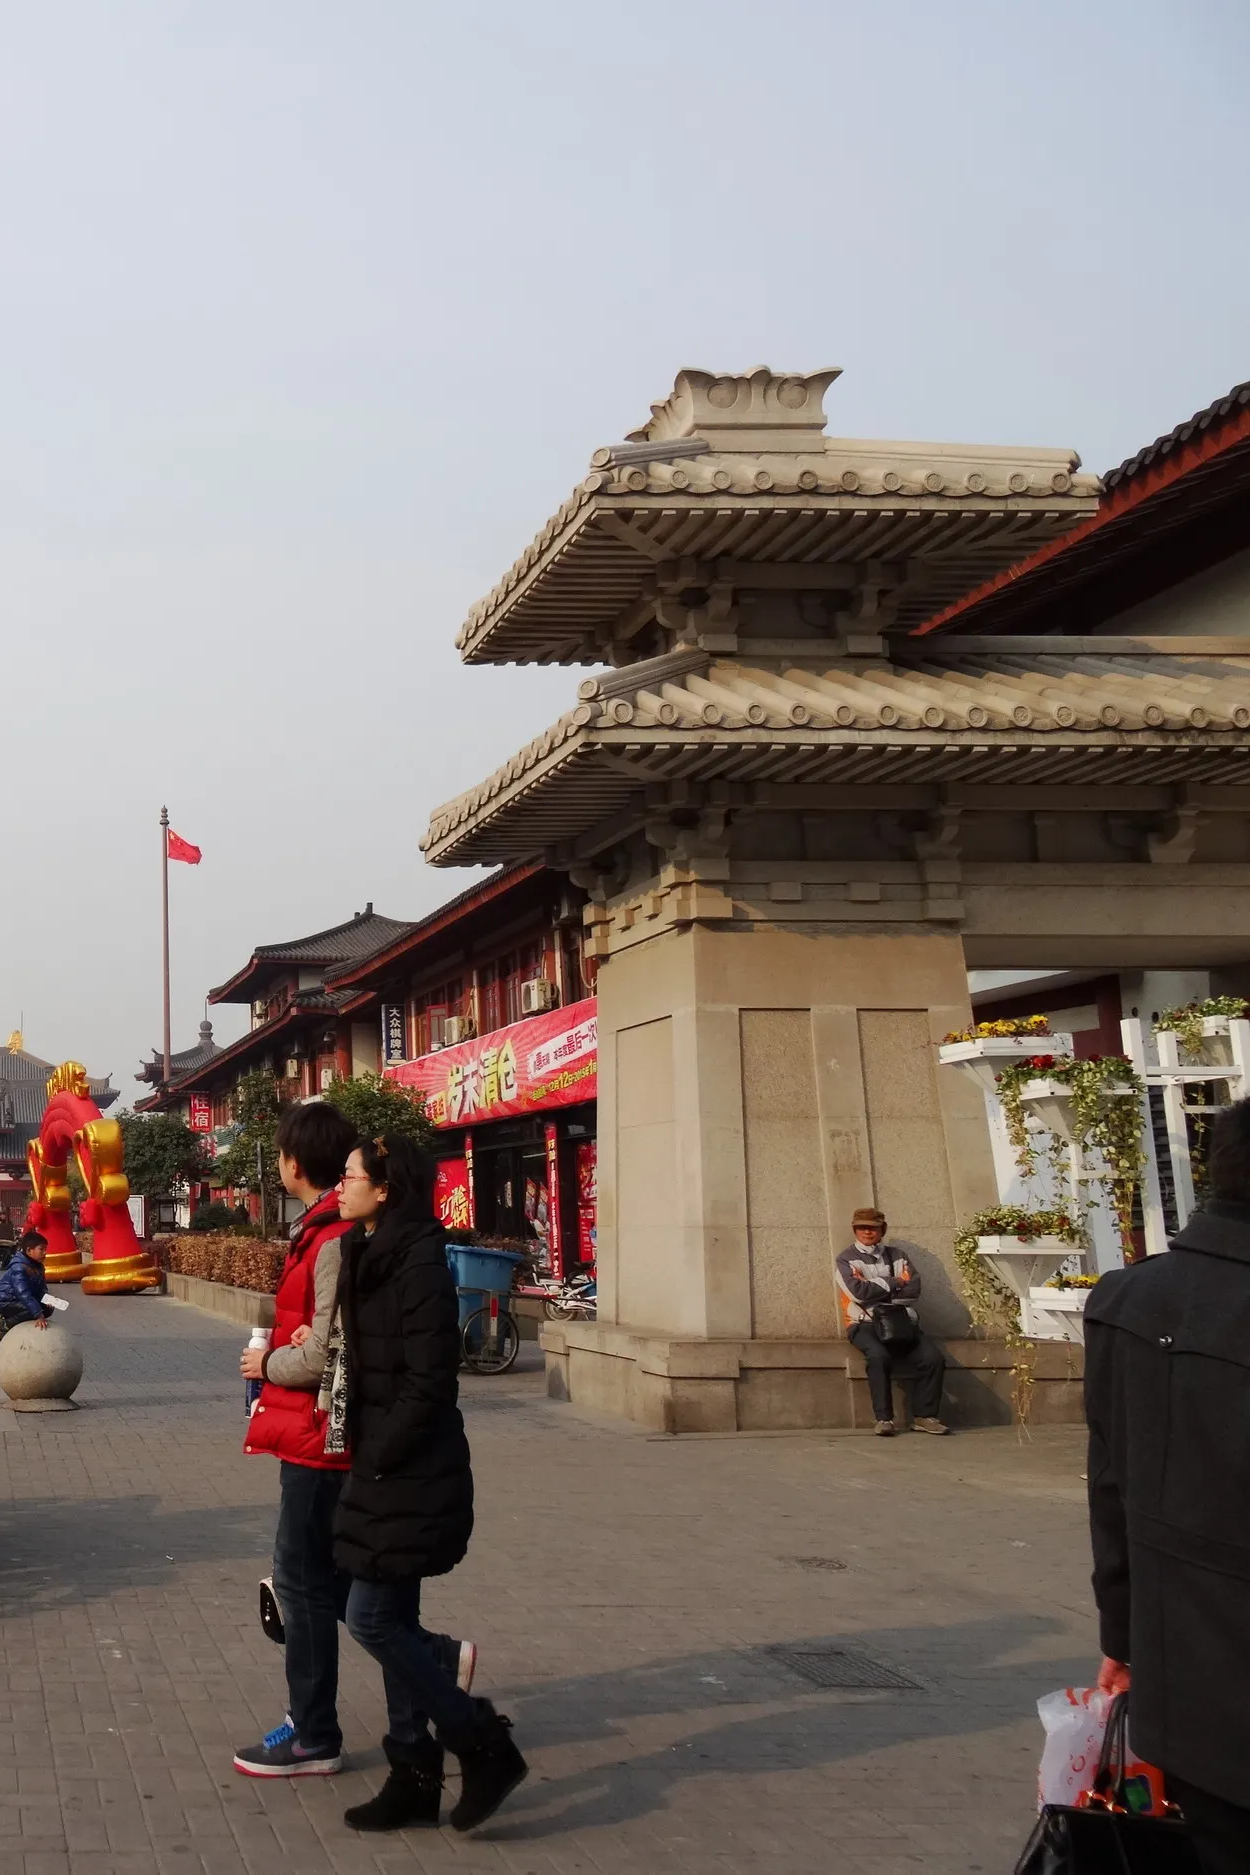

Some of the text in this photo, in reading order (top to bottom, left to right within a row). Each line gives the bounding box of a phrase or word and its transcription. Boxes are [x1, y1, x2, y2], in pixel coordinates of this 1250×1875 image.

[389, 1007, 403, 1060] 大众棋牌室
[447, 1039, 518, 1123] 岁末清仓
[194, 1095, 209, 1127] 住宿
